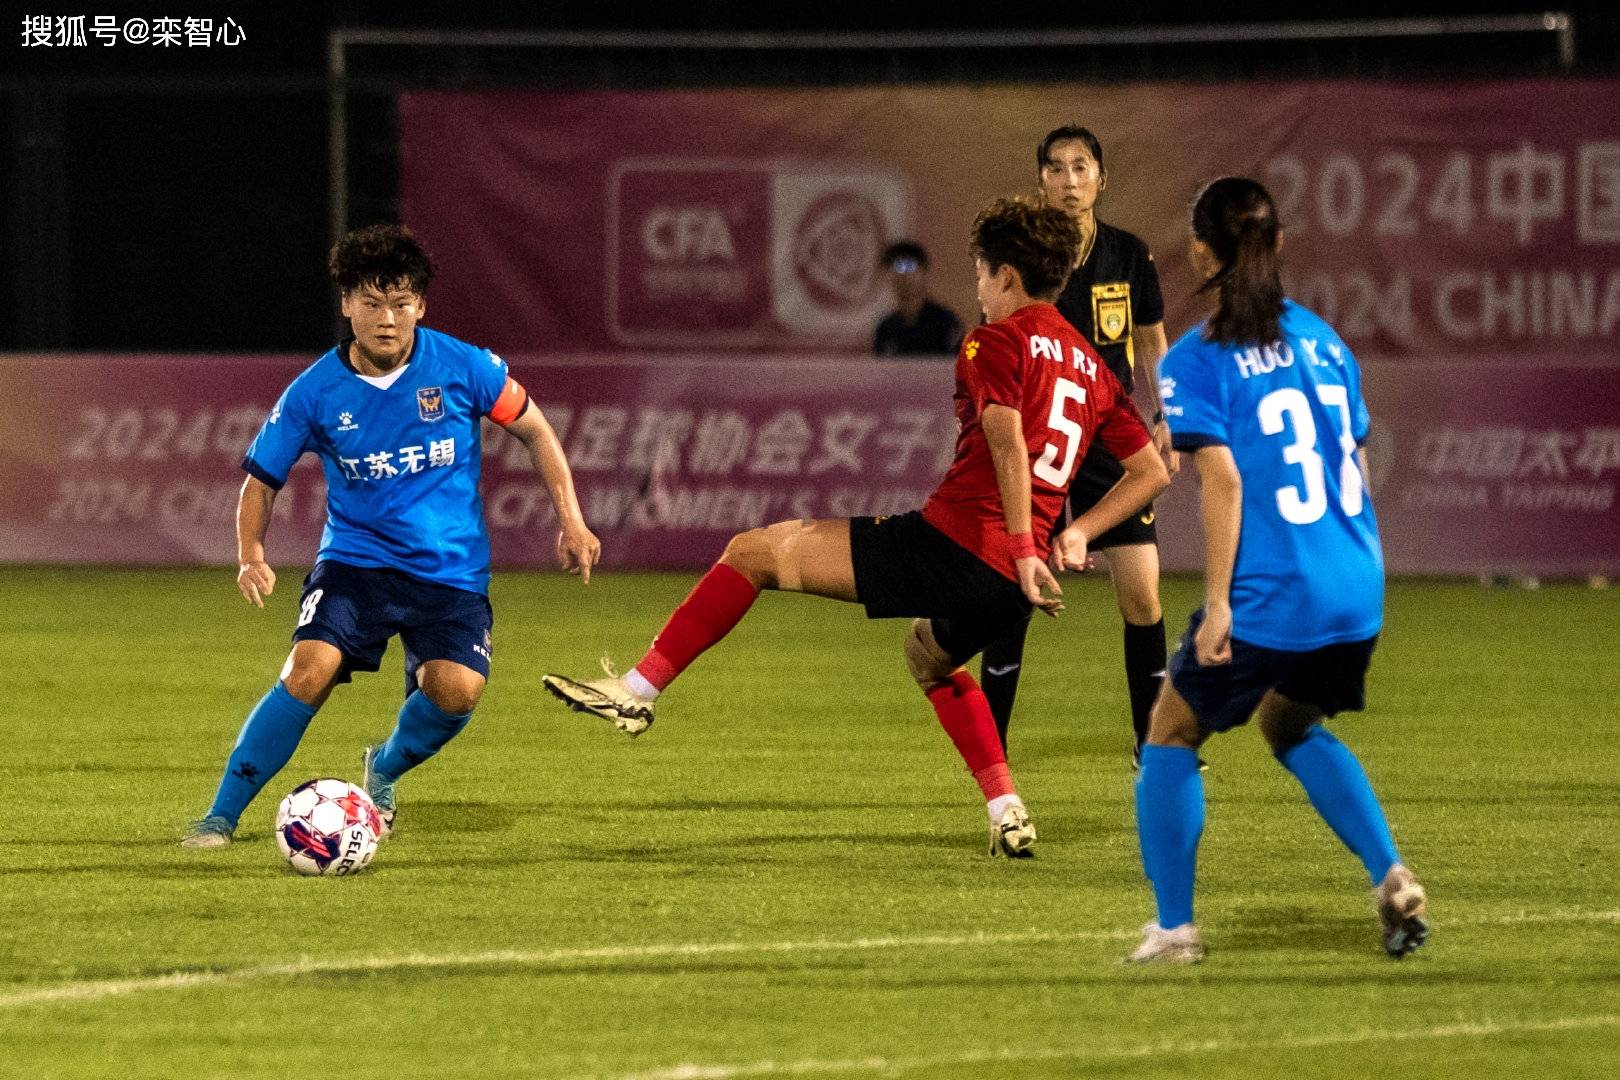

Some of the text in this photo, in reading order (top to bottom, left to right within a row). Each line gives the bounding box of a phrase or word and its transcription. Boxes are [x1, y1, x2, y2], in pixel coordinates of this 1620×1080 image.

[642, 210, 737, 260] CFA
[1029, 334, 1064, 363] AN
[1233, 340, 1295, 379] HUO
[1032, 376, 1087, 488] 5
[339, 437, 455, 481] 江苏无锡
[1256, 386, 1364, 526] 37
